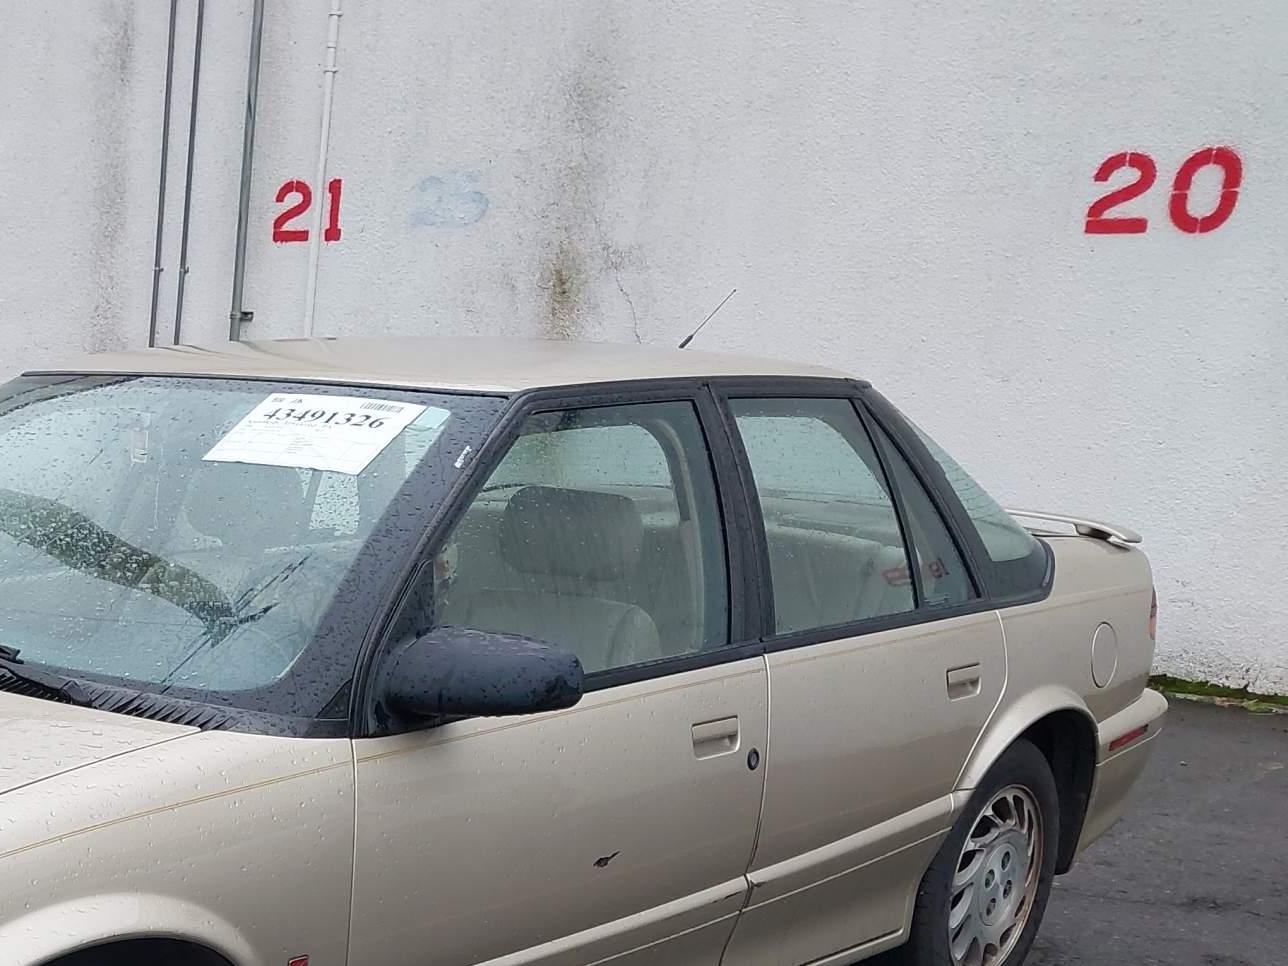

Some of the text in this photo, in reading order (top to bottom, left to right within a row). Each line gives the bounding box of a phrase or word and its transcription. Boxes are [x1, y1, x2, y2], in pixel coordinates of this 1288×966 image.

[272, 178, 344, 242] 21
[1084, 146, 1243, 234] 20
[264, 407, 390, 429] 43491326
